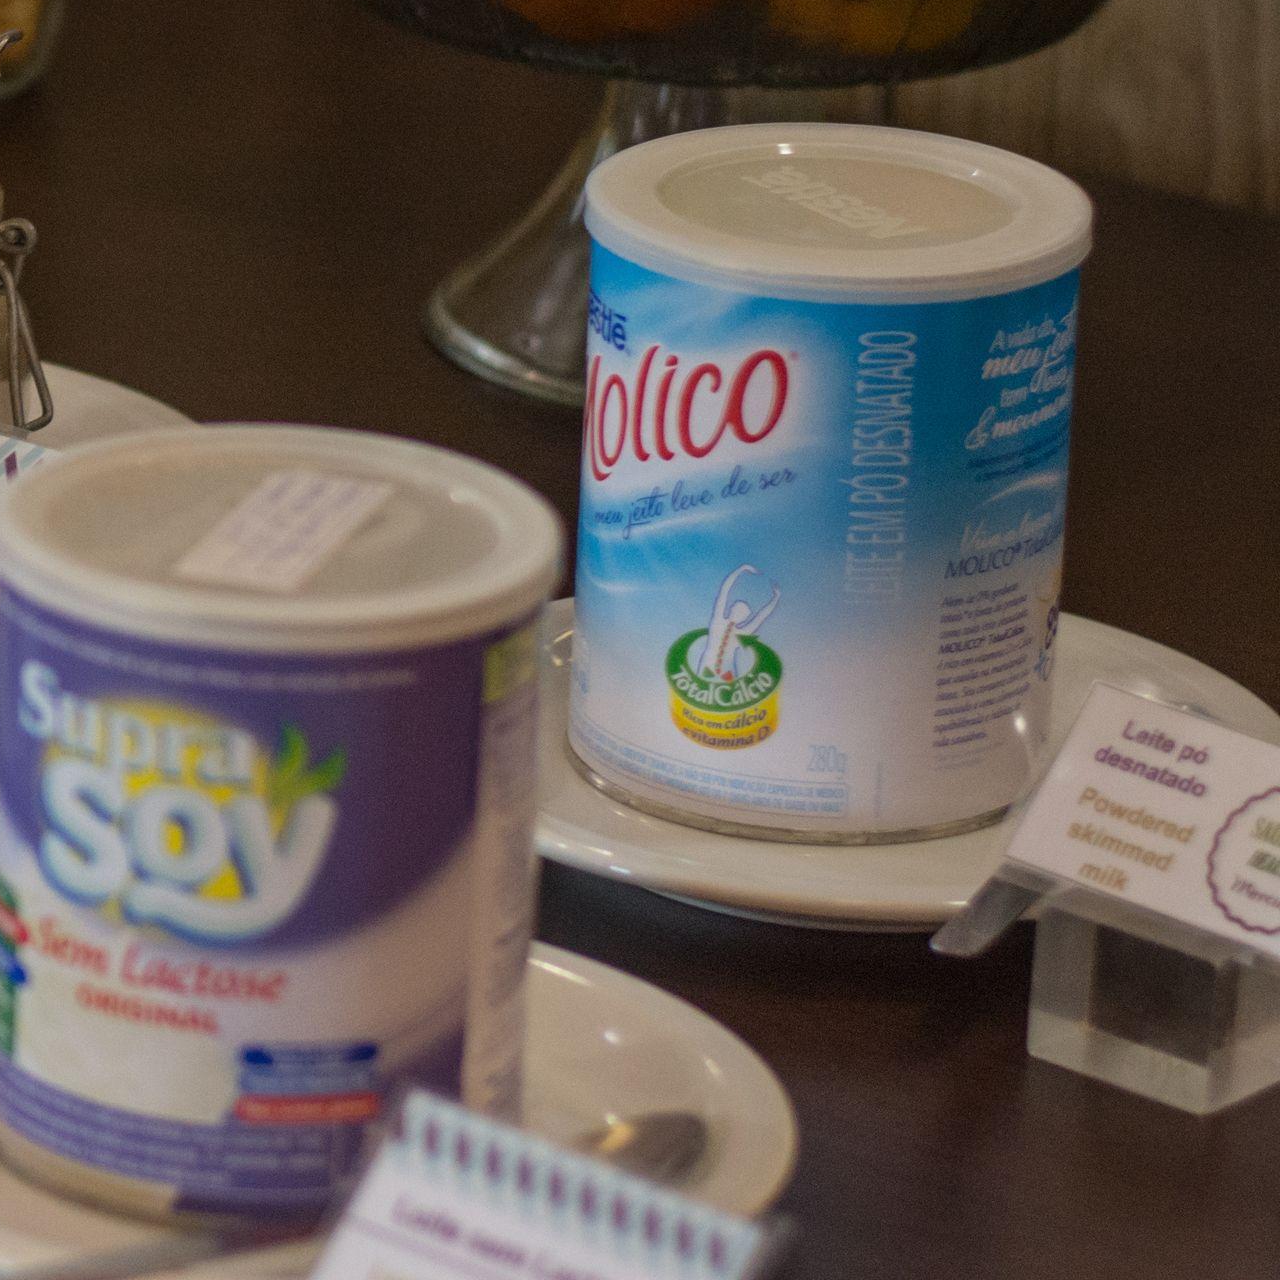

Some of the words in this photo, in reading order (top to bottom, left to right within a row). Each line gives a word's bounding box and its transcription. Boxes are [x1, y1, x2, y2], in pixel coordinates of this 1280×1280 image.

[851, 329, 918, 467] DESNATADO
[594, 508, 623, 525] meu
[623, 486, 670, 540] jeito
[671, 480, 714, 513] leve
[720, 464, 752, 496] de
[758, 467, 797, 491] ser
[841, 472, 910, 505] PÓ
[847, 509, 906, 545] EM
[671, 665, 774, 708] TotalCálcio
[18, 658, 257, 786] Supra
[692, 730, 755, 747] vitamina
[758, 726, 771, 741] D
[724, 707, 768, 730] cálcio
[1122, 719, 1177, 754] Leite
[1177, 743, 1209, 765] pó
[1093, 745, 1208, 798] desnatado
[1078, 785, 1196, 845] Powdered
[1066, 821, 1177, 872] skimmed
[1078, 863, 1130, 891] milk
[34, 913, 109, 976] Sem
[122, 940, 288, 1003] Lactose
